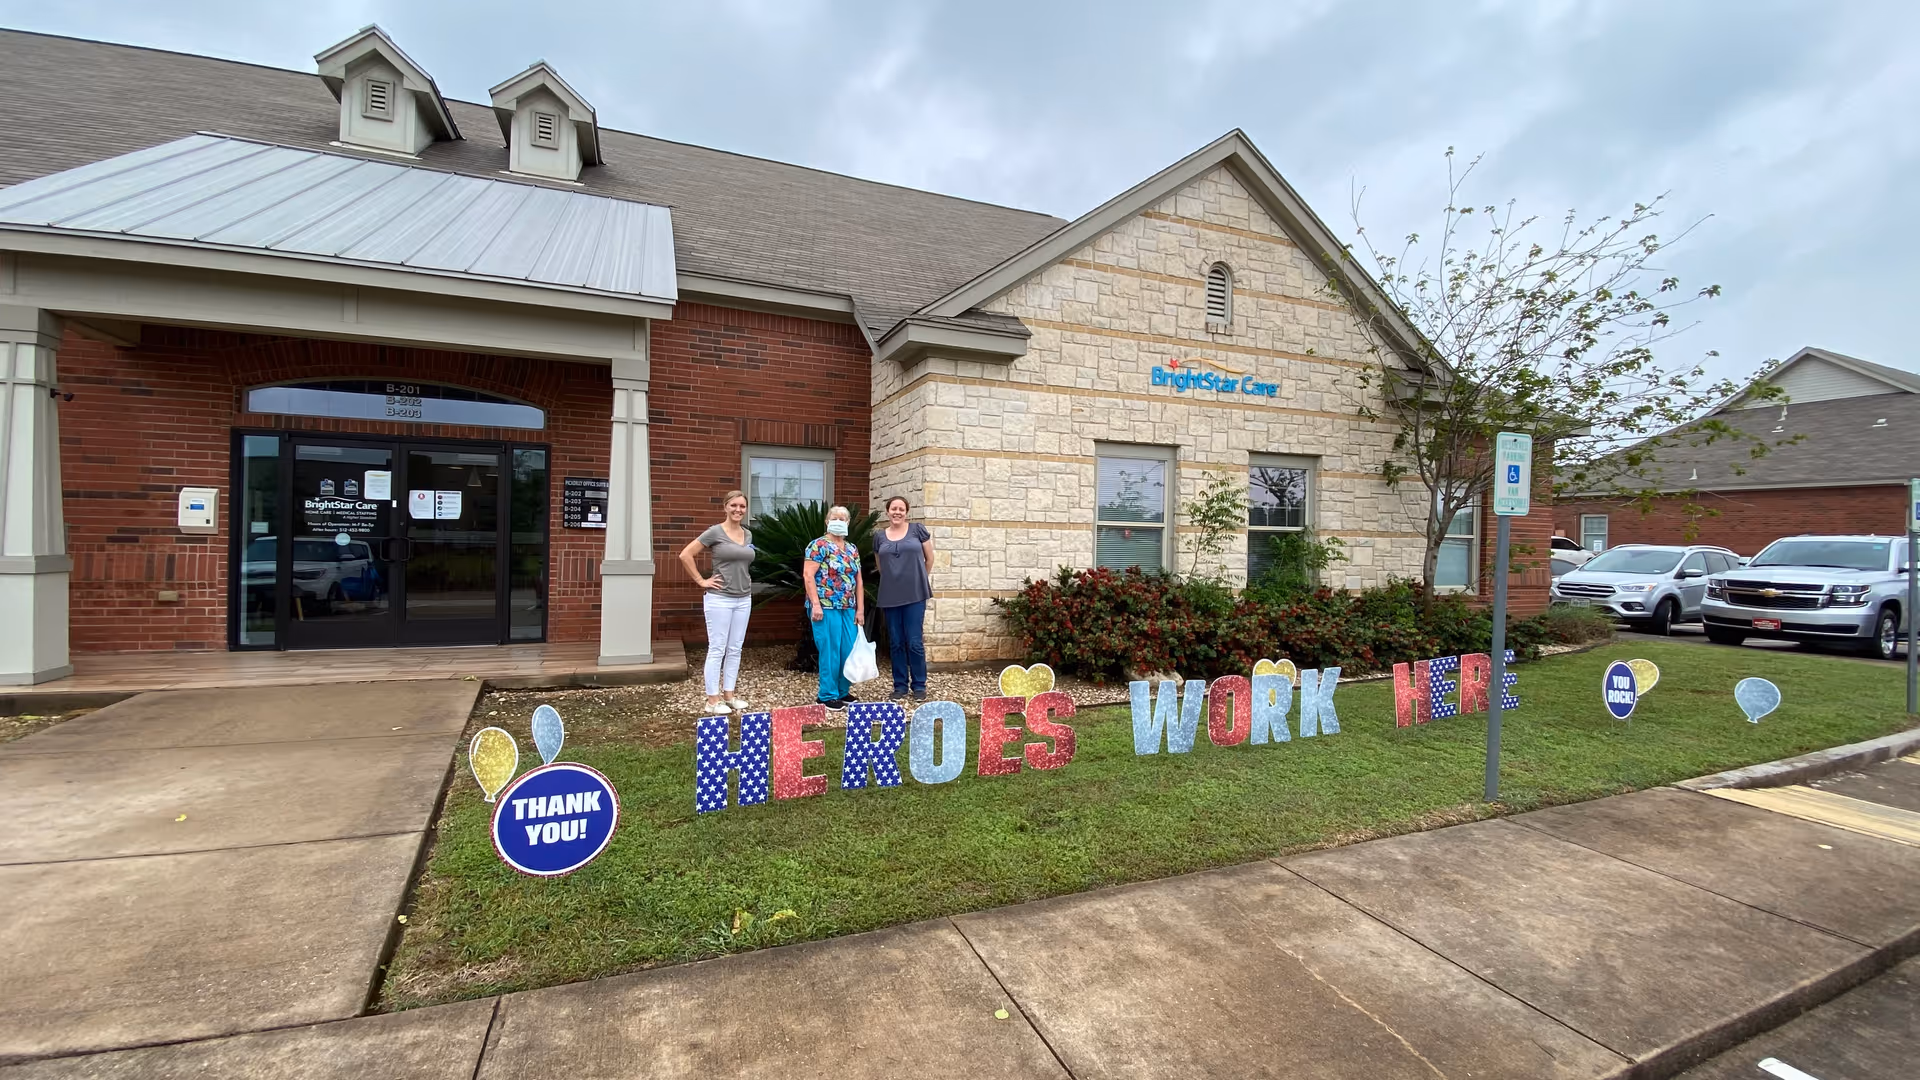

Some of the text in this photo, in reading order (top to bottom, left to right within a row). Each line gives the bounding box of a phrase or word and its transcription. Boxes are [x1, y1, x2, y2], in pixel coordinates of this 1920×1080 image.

[1151, 366, 1278, 397] BrightStar Care
[386, 384, 420, 394] B-201
[386, 396, 421, 406] B-202
[386, 407, 421, 418] B-203
[305, 500, 354, 510] BrightStar
[1613, 676, 1630, 689] YOU
[1608, 690, 1633, 704] ROCK!
[696, 649, 1519, 814] HEROES WORK HERE
[512, 790, 602, 820] THANK
[524, 818, 587, 846] YOU!
